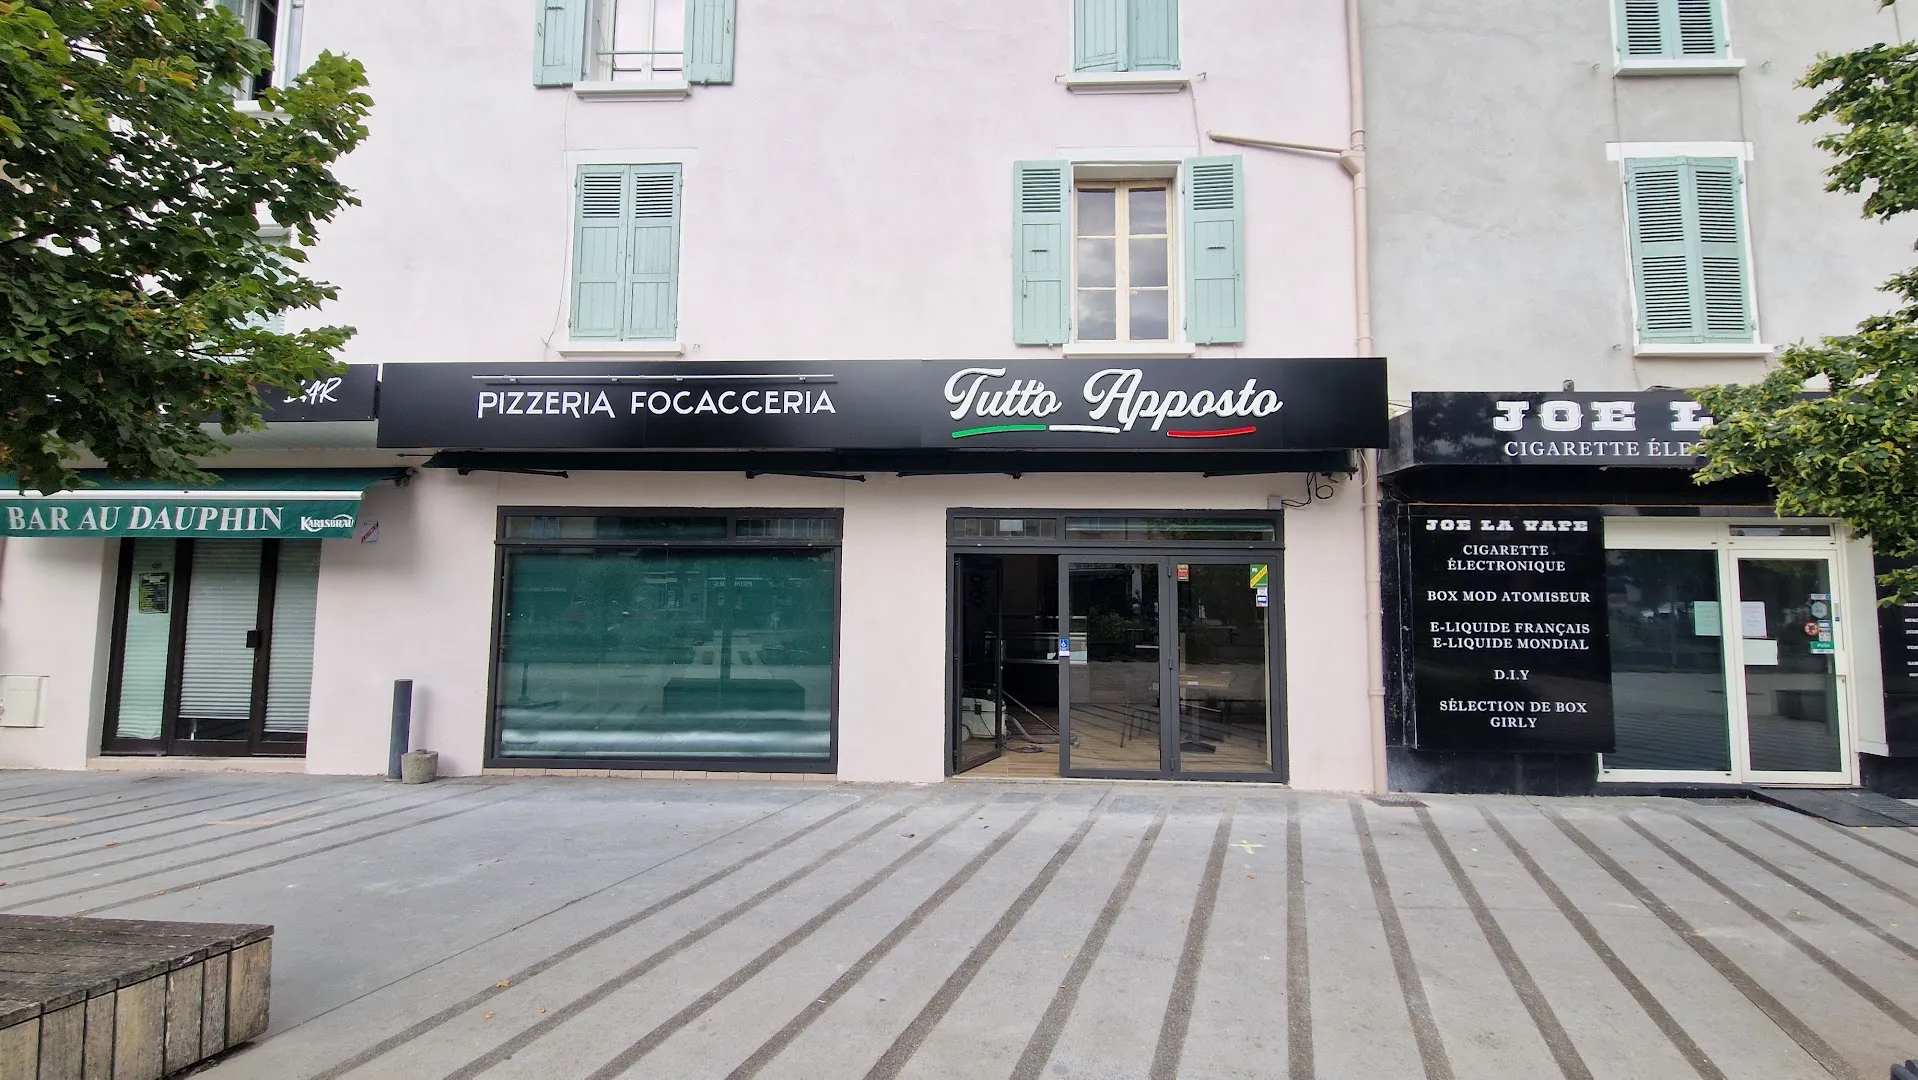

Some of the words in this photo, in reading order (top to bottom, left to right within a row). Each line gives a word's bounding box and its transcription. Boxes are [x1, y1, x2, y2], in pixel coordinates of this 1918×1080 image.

[478, 391, 615, 418] PIZZERIA
[631, 390, 836, 414] FOCACCERIA
[943, 367, 1062, 421] Tutto
[1082, 367, 1283, 431] Apposto
[1493, 401, 1636, 432] JOE
[1504, 442, 1640, 457] CIGARETTE
[7, 507, 70, 531] BAR
[78, 507, 121, 531] AU
[127, 506, 284, 531] DAUPHIN
[1425, 519, 1472, 531] JOE
[1480, 519, 1515, 532] LA
[1523, 519, 1589, 532] VAPE
[1463, 544, 1549, 556] CIGARETTE
[1447, 557, 1566, 572] ÉLECTRONIQUE
[1427, 590, 1458, 602] BOX
[1463, 590, 1497, 602] MOD
[1502, 591, 1591, 603] ATOMISEUR
[1430, 621, 1510, 634] E-LIQUIDE
[1515, 622, 1591, 636] FRANÇAIS
[1432, 637, 1513, 651] E-LIQUIDE
[1517, 638, 1589, 650] MONDIAL
[1493, 669, 1529, 681] D.I.Y
[1439, 697, 1525, 712] SÉLECTION
[1530, 701, 1551, 712] DE
[1556, 702, 1588, 713] BOX
[1490, 716, 1537, 728] GIRLY
